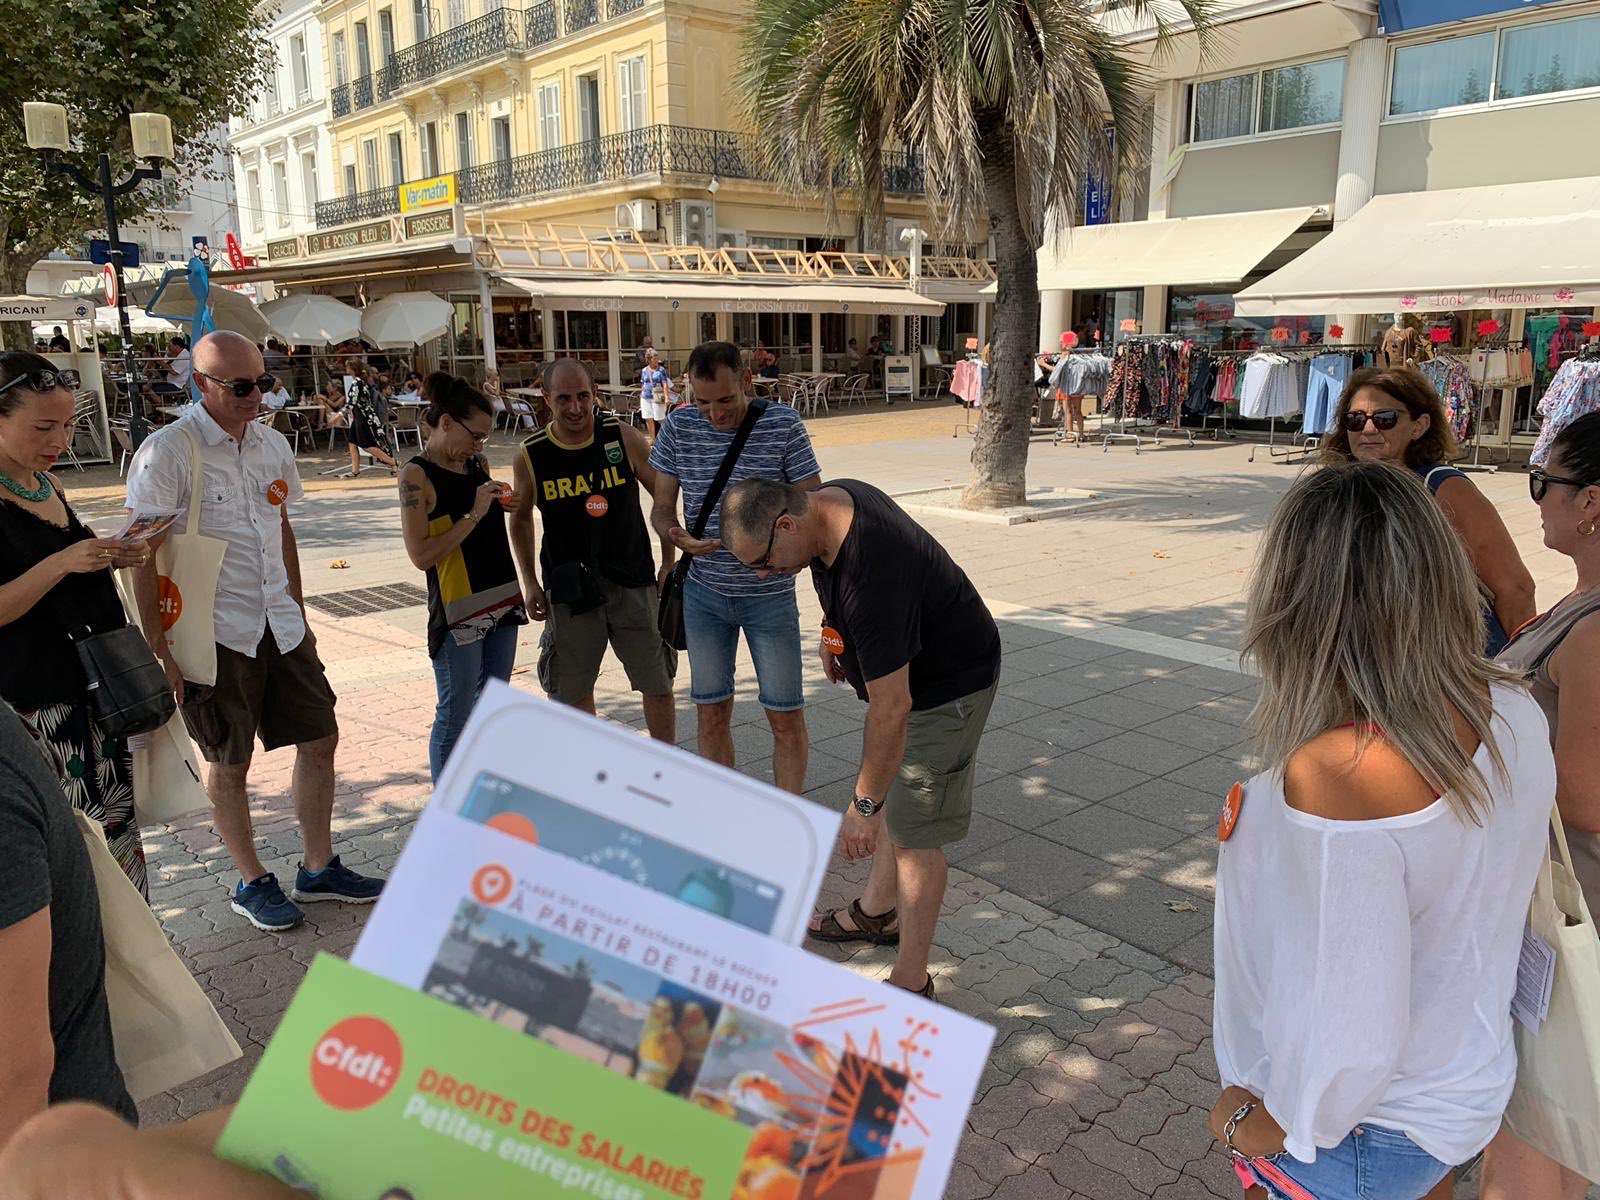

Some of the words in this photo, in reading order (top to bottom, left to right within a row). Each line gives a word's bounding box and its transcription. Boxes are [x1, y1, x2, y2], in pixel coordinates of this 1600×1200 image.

[405, 180, 448, 204] Var-matin
[412, 216, 450, 234] BRASSERIE
[323, 236, 332, 249] LE
[334, 231, 358, 247] POUSSIN
[362, 228, 377, 243] BLEU
[229, 242, 243, 270] TABA
[273, 243, 296, 257] GLACIER
[582, 299, 624, 311] GLACIER
[1477, 288, 1542, 305] Madame
[0, 306, 47, 315] RICANT
[720, 301, 731, 312] LE
[736, 301, 783, 313] POUSSIN
[786, 302, 809, 313] BLEU
[159, 597, 178, 614] dt:
[537, 903, 632, 956] PARTIR
[641, 945, 679, 974] DE
[690, 964, 772, 1012] 18H00
[403, 1091, 497, 1153] Petites
[416, 1066, 519, 1126] DROITS
[519, 1107, 575, 1150] DES
[576, 1131, 705, 1200] SALARIÉS
